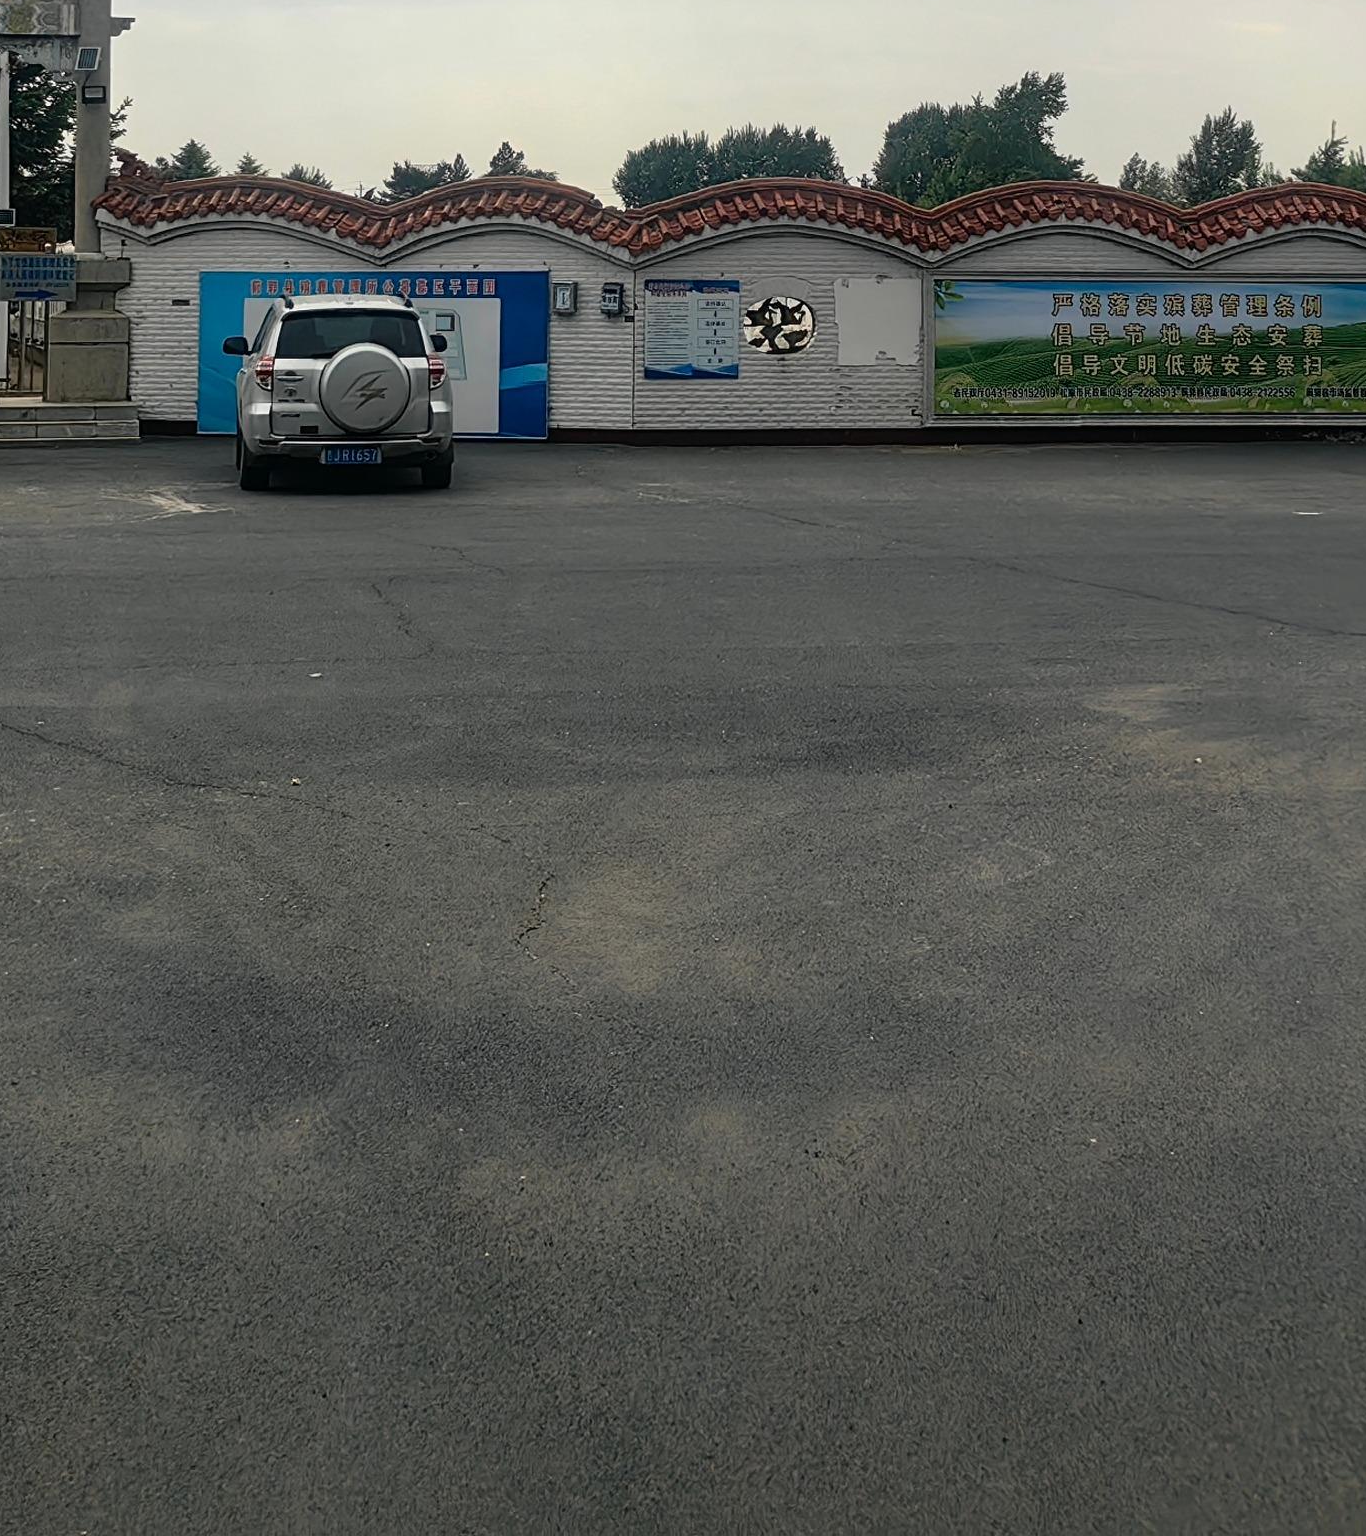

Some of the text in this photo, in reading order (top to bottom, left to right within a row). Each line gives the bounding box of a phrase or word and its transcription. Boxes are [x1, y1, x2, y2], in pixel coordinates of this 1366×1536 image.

[1052, 293, 1323, 318] 严格落实殡葬管理条例
[1051, 323, 1323, 348] 倡导节地生态安葬
[1053, 353, 1323, 377] 倡导文明低碳安全祭扫
